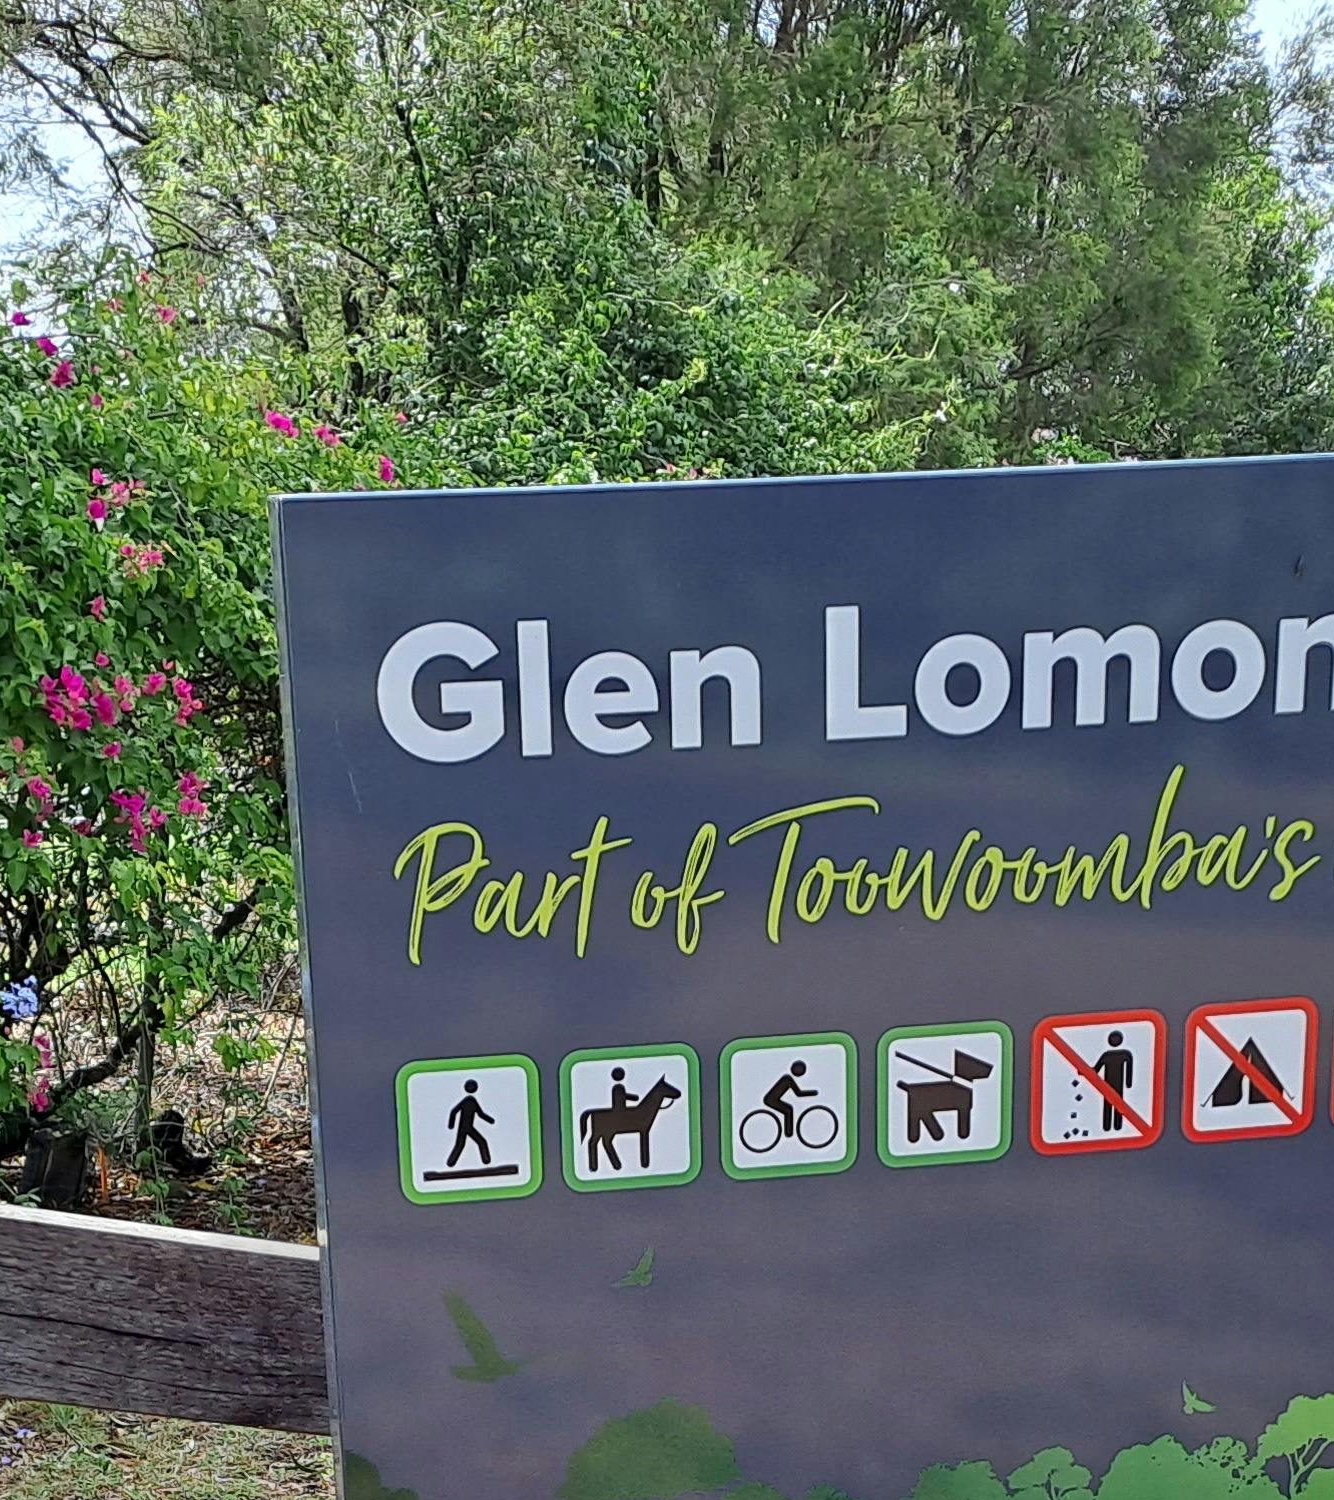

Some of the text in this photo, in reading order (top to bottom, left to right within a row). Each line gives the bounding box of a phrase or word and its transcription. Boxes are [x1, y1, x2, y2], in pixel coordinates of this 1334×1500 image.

[377, 619, 761, 763] Glen
[394, 816, 632, 965] Part
[630, 823, 725, 955] of
[728, 764, 1320, 943] Toowoomba's
